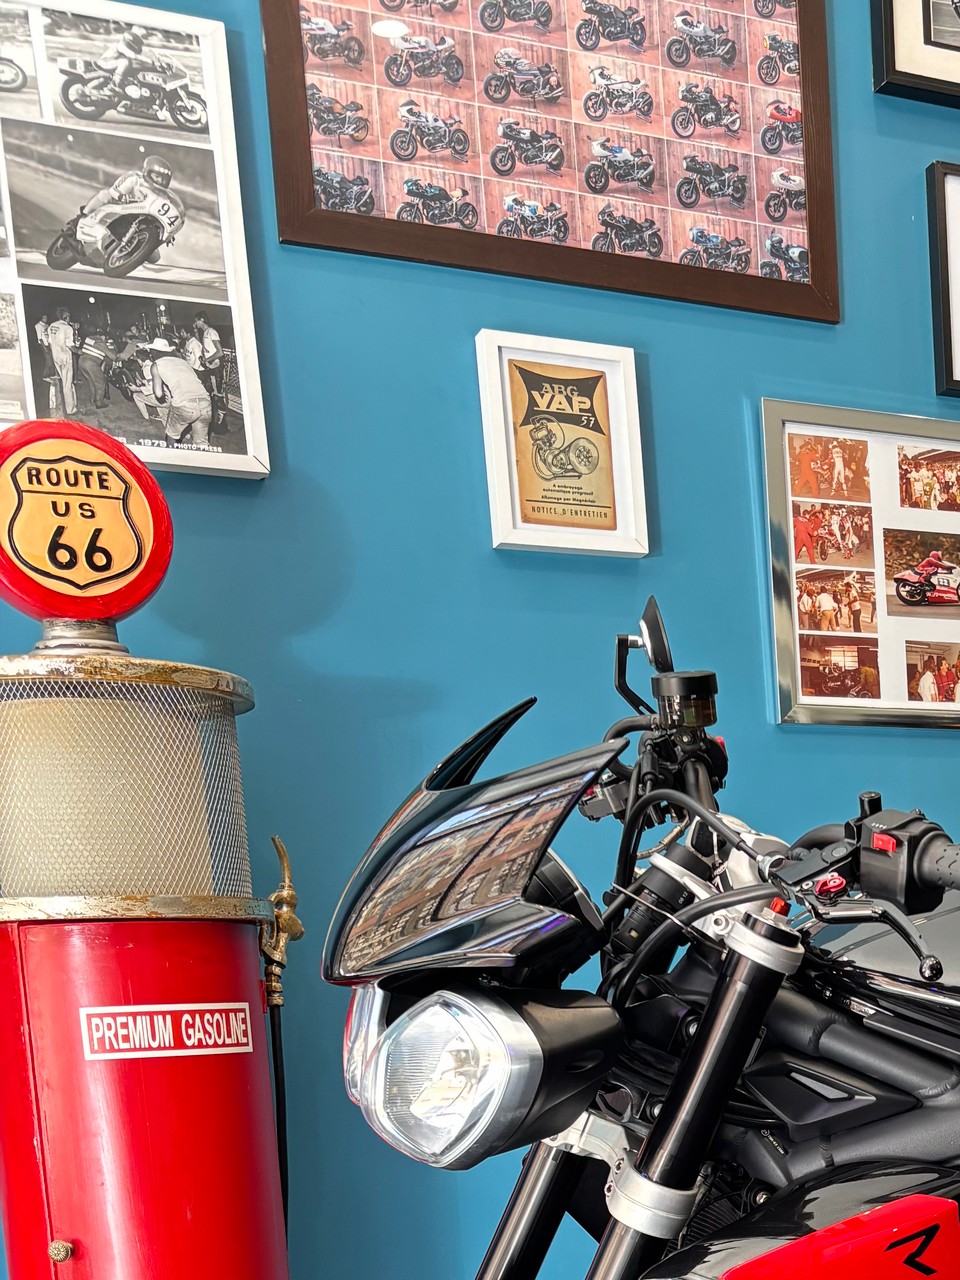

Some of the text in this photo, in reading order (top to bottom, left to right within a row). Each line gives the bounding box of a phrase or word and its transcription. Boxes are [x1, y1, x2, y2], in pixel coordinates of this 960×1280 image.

[157, 203, 180, 229] 94
[580, 416, 596, 428] 57
[27, 466, 111, 491] ROUTE
[531, 506, 558, 515] NOTICE
[47, 525, 113, 573] 66
[90, 1012, 248, 1051] PREMIUM GASOLINE
